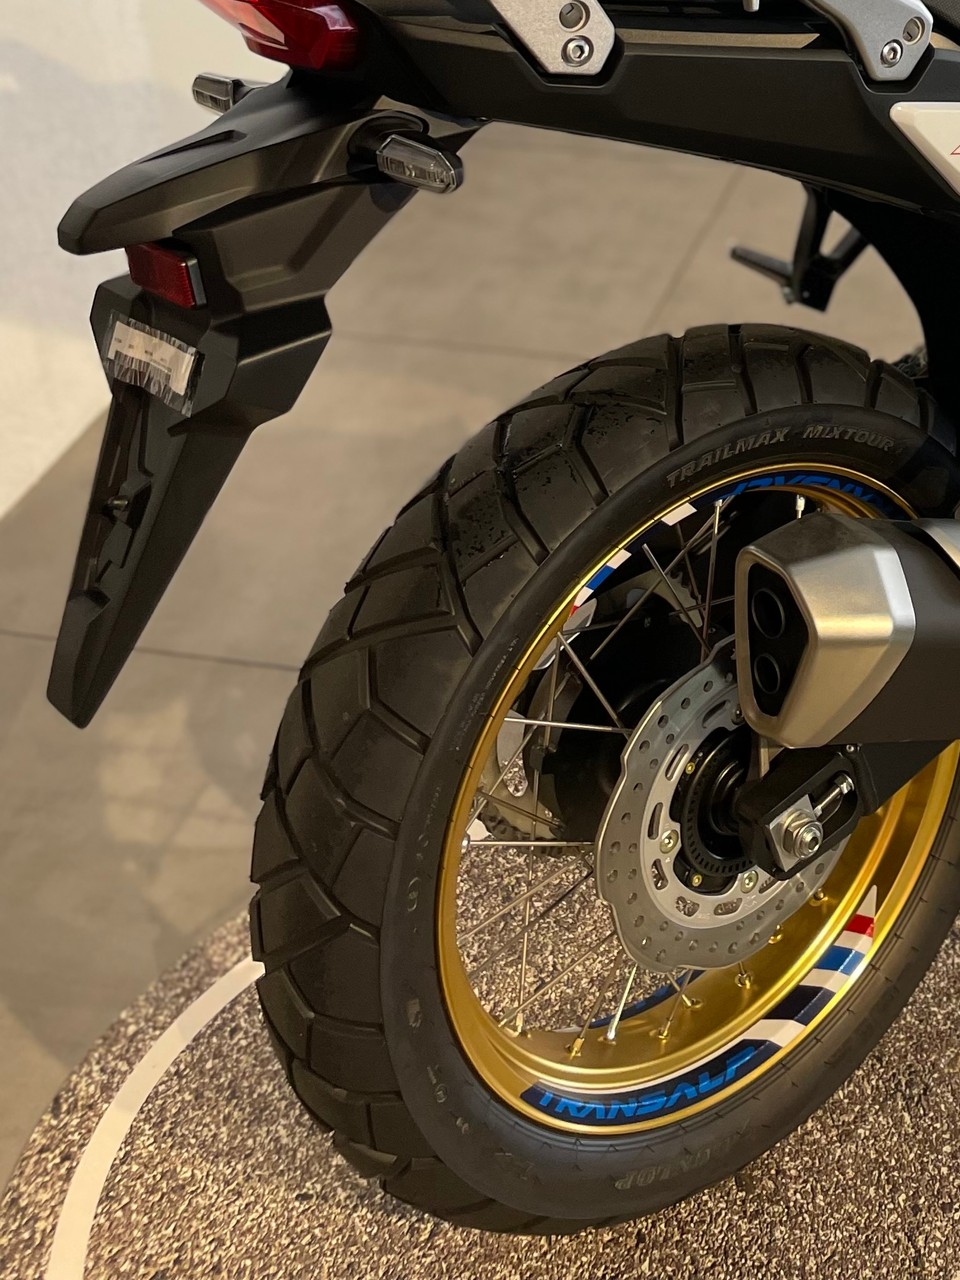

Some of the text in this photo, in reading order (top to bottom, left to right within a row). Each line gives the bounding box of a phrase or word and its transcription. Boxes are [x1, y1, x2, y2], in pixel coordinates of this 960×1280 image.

[666, 424, 895, 489] TRAILMAX MIXTOUR
[538, 1045, 757, 1120] TRANSALP
